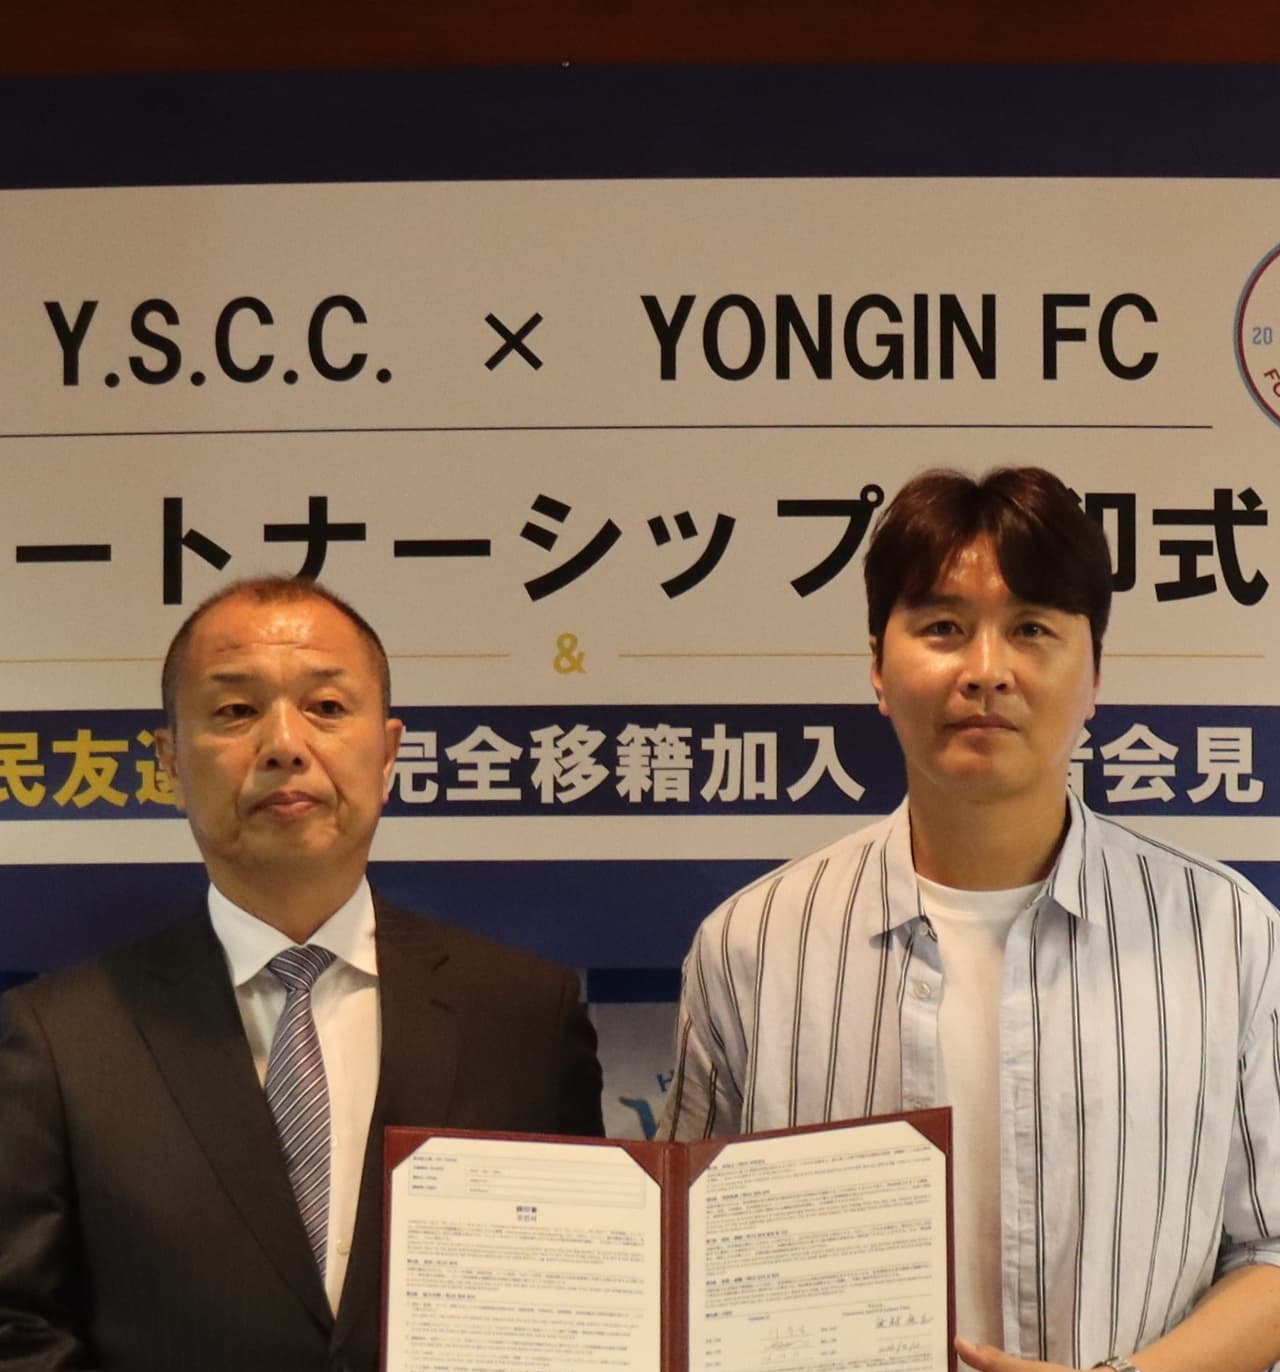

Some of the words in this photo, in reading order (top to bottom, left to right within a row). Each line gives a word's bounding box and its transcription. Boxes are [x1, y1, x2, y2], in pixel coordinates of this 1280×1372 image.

[44, 295, 392, 387] Y.S.C.C.
[640, 292, 997, 382] YONGIN
[1043, 291, 1160, 381] FC
[1252, 327, 1273, 345] 20
[552, 632, 587, 674] &
